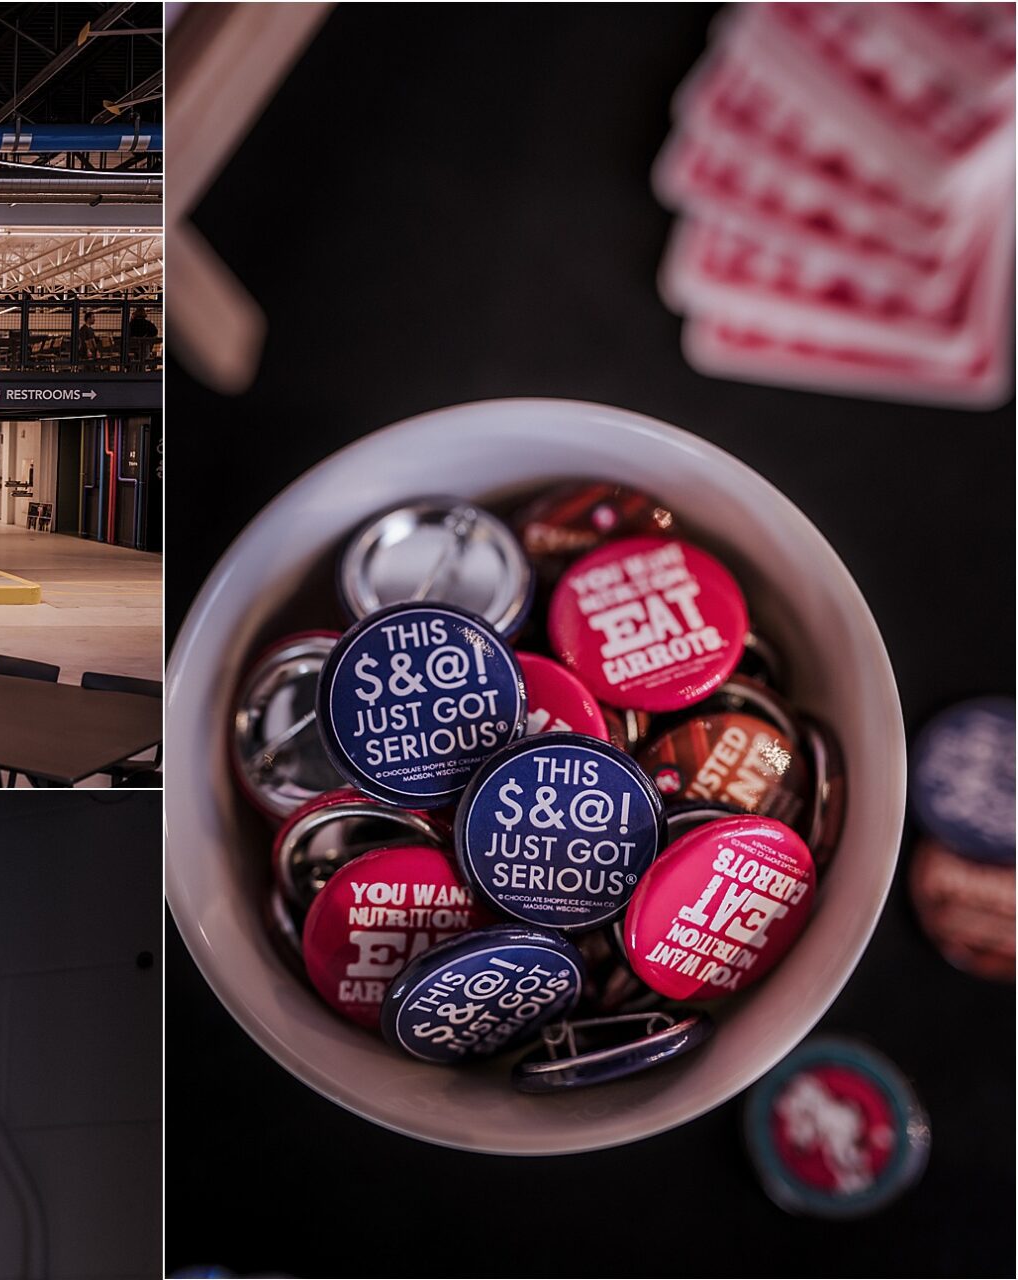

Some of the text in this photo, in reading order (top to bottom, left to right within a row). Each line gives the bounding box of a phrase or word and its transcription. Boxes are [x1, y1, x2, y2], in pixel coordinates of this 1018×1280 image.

[6, 389, 81, 400] RESTROOMS
[381, 619, 448, 651] THIS
[588, 580, 704, 659] EAT
[354, 641, 488, 705] $&@!
[353, 701, 422, 737] JUST
[432, 690, 499, 723] GOT
[382, 766, 421, 777] CHOCOLATE
[422, 762, 445, 772] SHOPPE
[436, 766, 471, 777] WISCONSIN
[533, 756, 599, 786] THIS
[494, 778, 631, 835] $&@!
[484, 832, 636, 866] JUST GOT
[350, 882, 407, 905] YOU
[504, 894, 542, 903] CHOCOLATE
[543, 897, 568, 905] SHOPPE
[555, 904, 591, 913] WISCONSIN
[678, 874, 789, 949] EAT
[346, 930, 469, 977] EA
[645, 941, 742, 991] YOU WANT
[408, 971, 467, 1013] THIS
[412, 957, 525, 1044] $&@!
[447, 964, 552, 1056] JUST GOT
